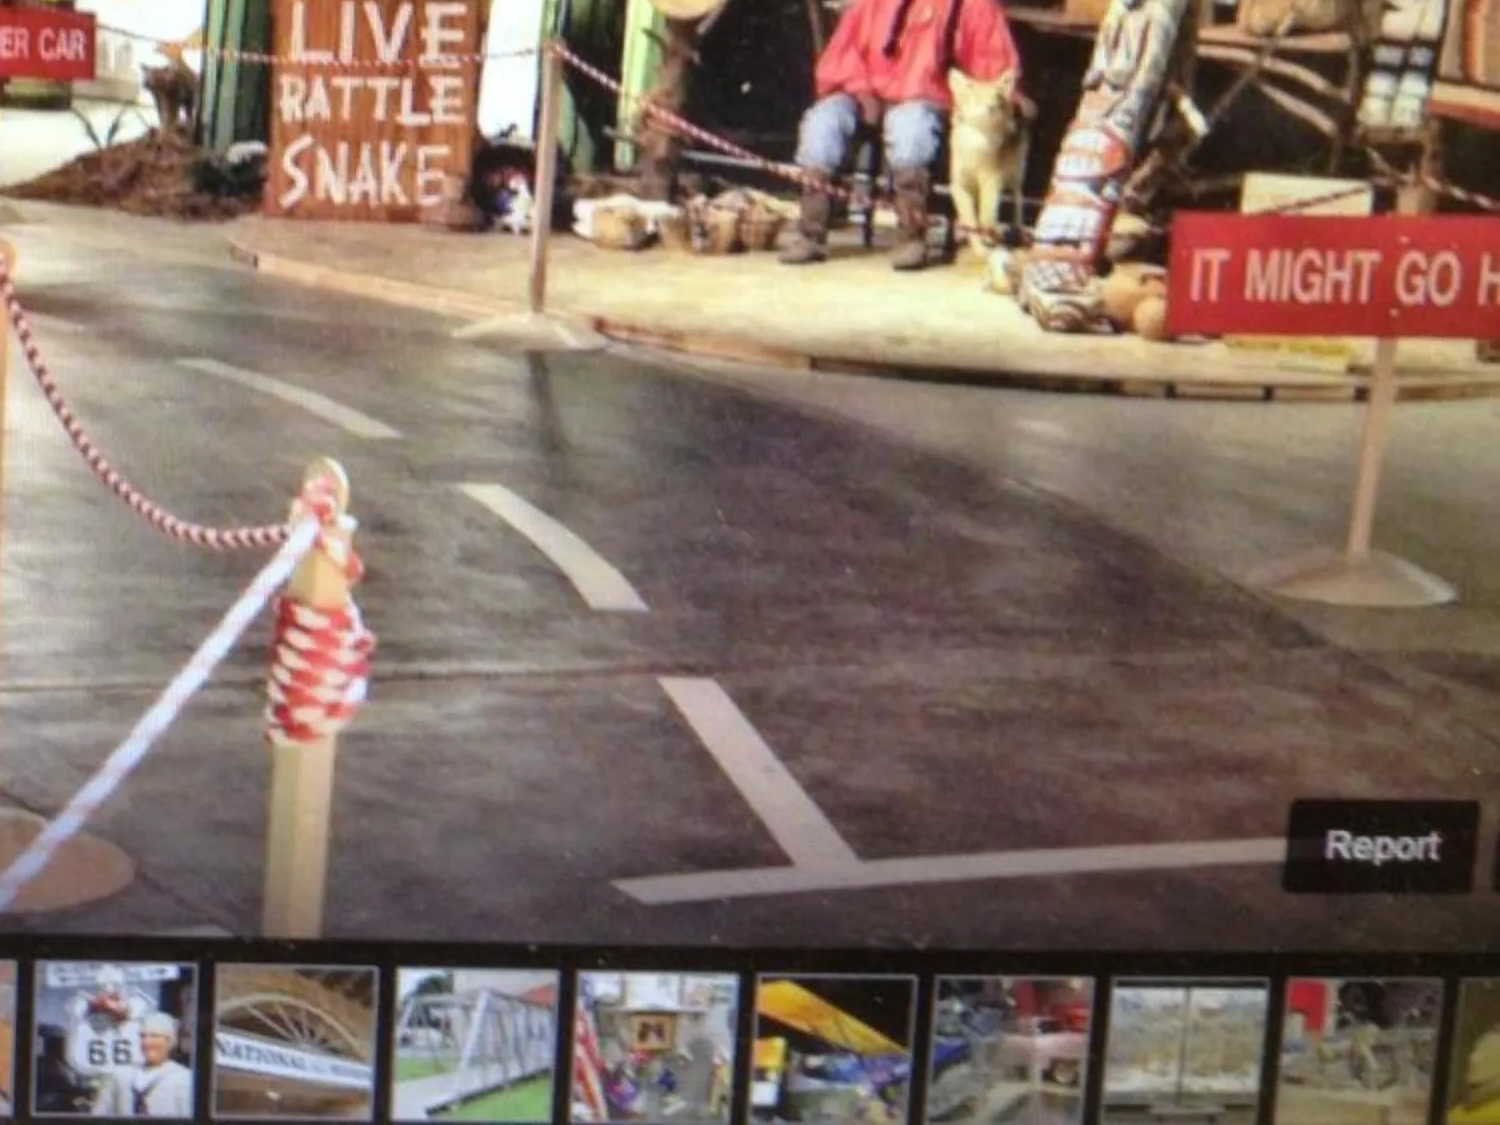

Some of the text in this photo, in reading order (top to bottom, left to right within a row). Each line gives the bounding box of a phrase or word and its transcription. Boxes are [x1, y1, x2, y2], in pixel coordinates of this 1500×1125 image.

[38, 27, 88, 62] CAR
[279, 74, 468, 126] RATTLE
[278, 133, 453, 209] SNAKE
[1189, 247, 1231, 303] IT
[1243, 246, 1382, 305] MIGHT
[1395, 250, 1462, 307] GO
[1324, 828, 1443, 867] Report
[87, 1038, 133, 1066] 66
